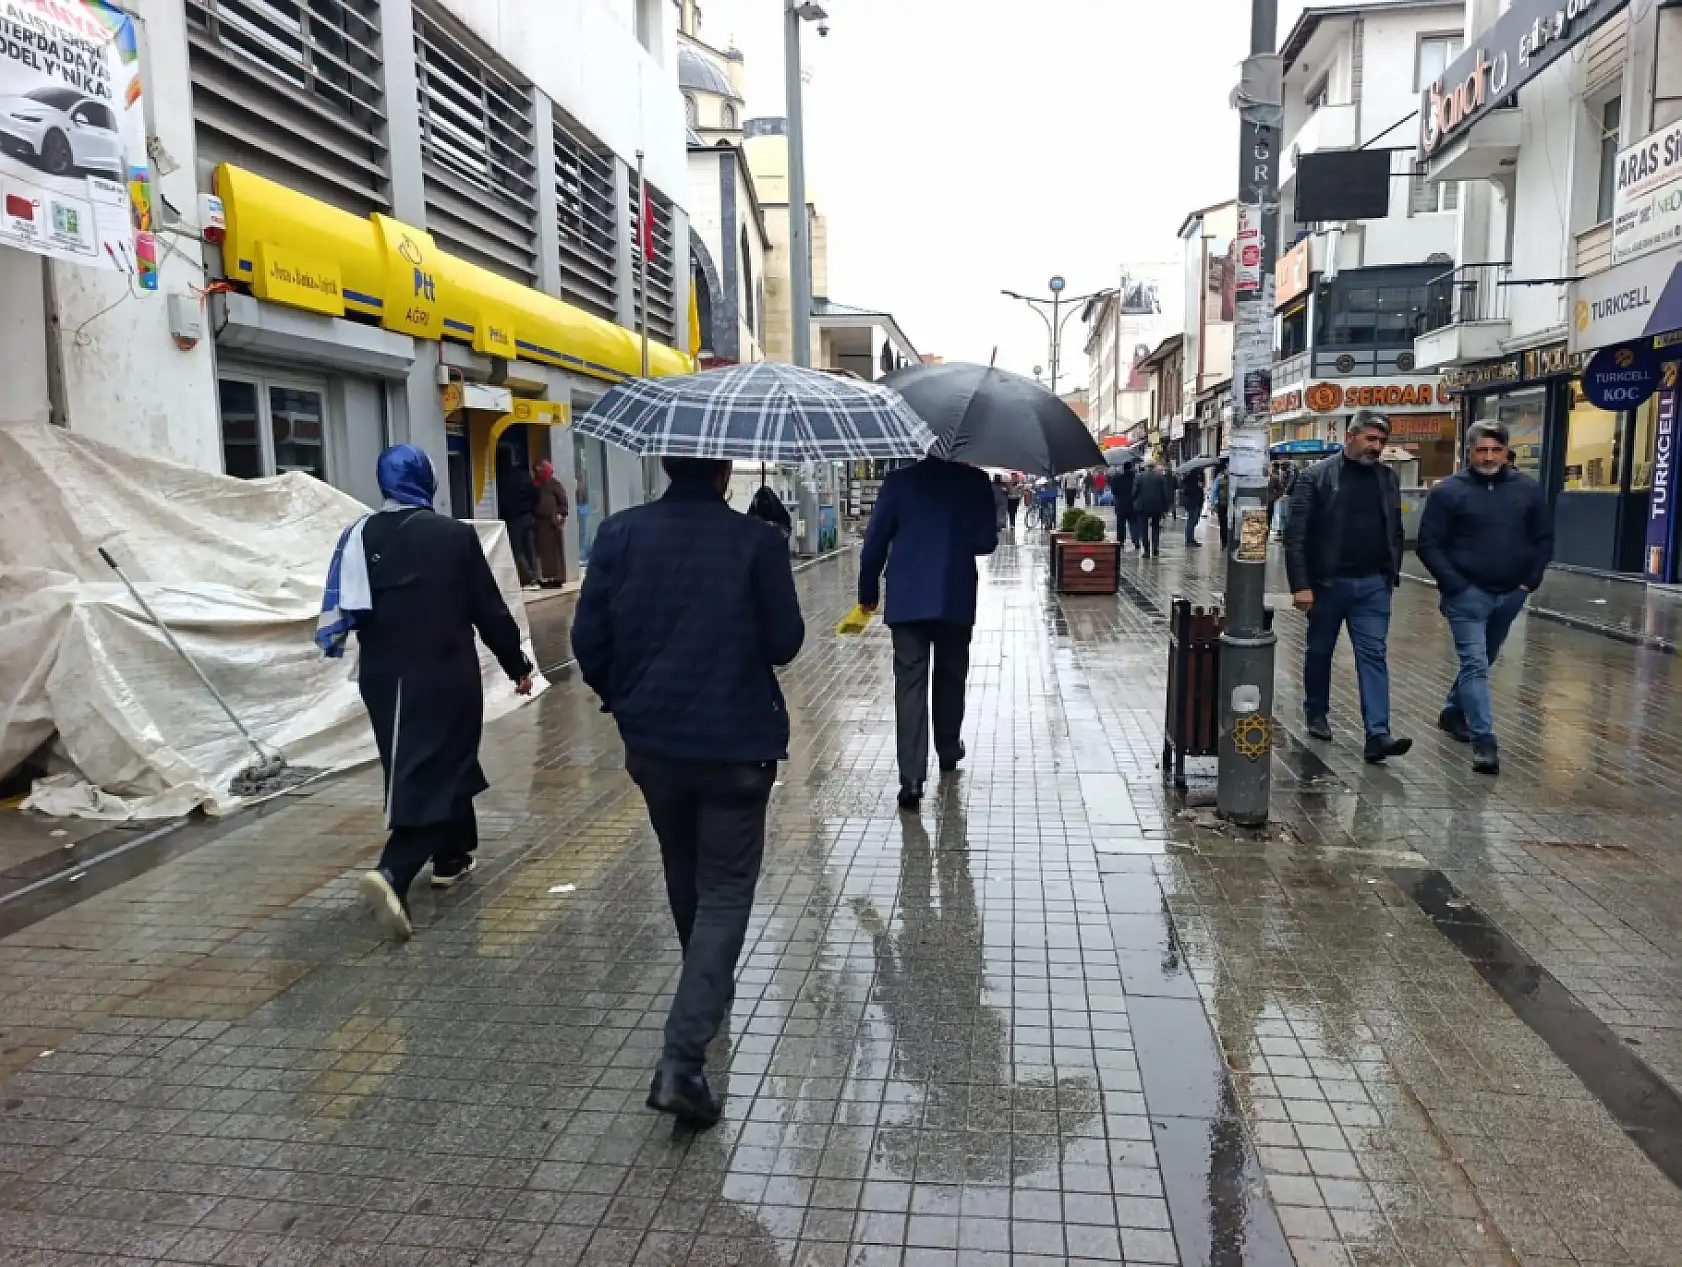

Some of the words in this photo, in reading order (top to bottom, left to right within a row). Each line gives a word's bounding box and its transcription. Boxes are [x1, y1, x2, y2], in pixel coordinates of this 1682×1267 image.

[1618, 141, 1659, 191] ARAS
[1591, 286, 1652, 321] TURKCELL
[1344, 383, 1433, 407] SERDAR
[1595, 371, 1652, 385] TURKCELL
[1652, 388, 1674, 520] TURKCELL
